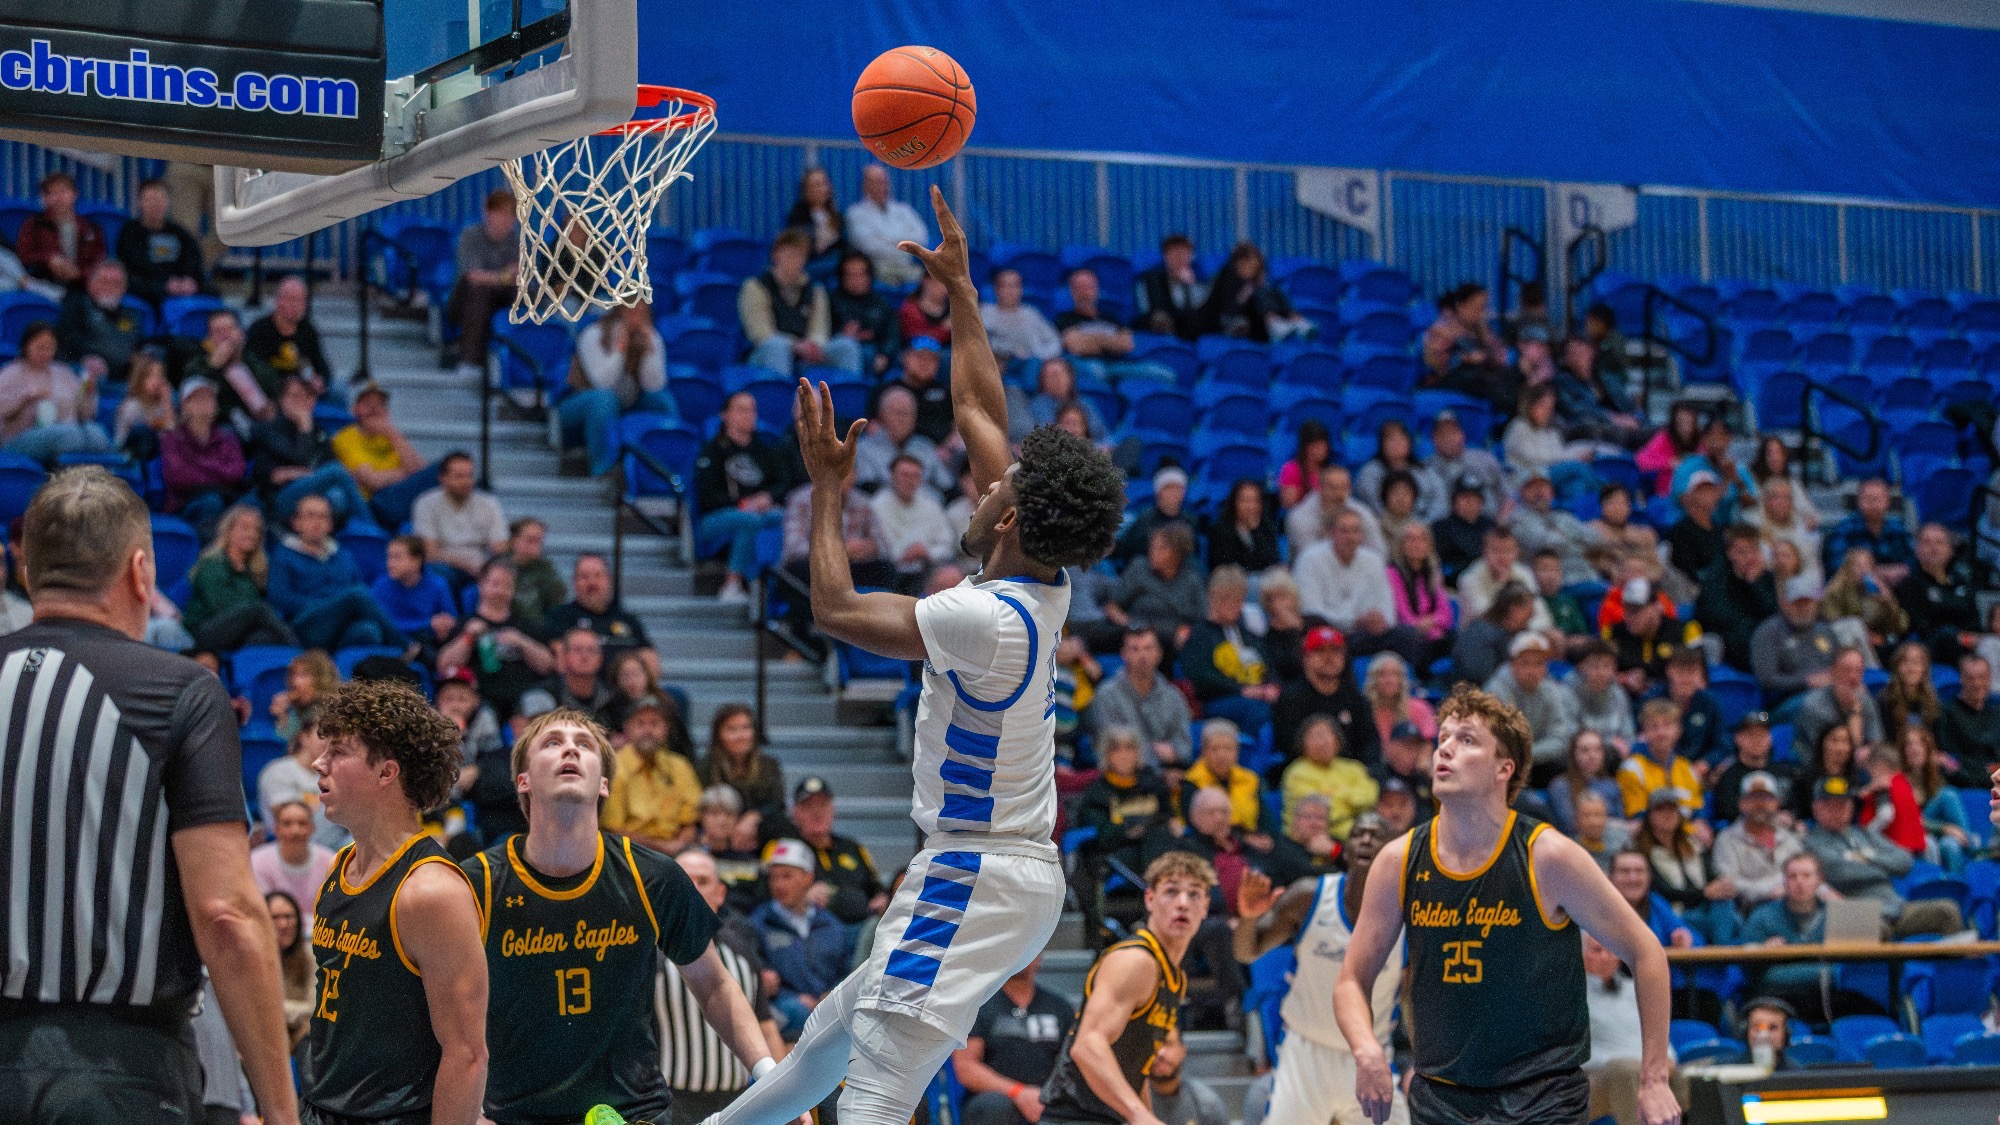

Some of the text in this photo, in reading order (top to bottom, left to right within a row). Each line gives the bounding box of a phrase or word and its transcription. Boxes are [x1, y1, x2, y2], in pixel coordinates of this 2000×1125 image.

[0, 39, 358, 119] cbruins.com
[1345, 177, 1368, 217] C
[502, 919, 639, 961] Golden Eagles
[1411, 897, 1522, 938] Golden Eagles
[312, 913, 381, 969] lden Eagles
[1442, 941, 1484, 984] 25
[317, 967, 340, 1022] 12
[555, 967, 592, 1016] 13
